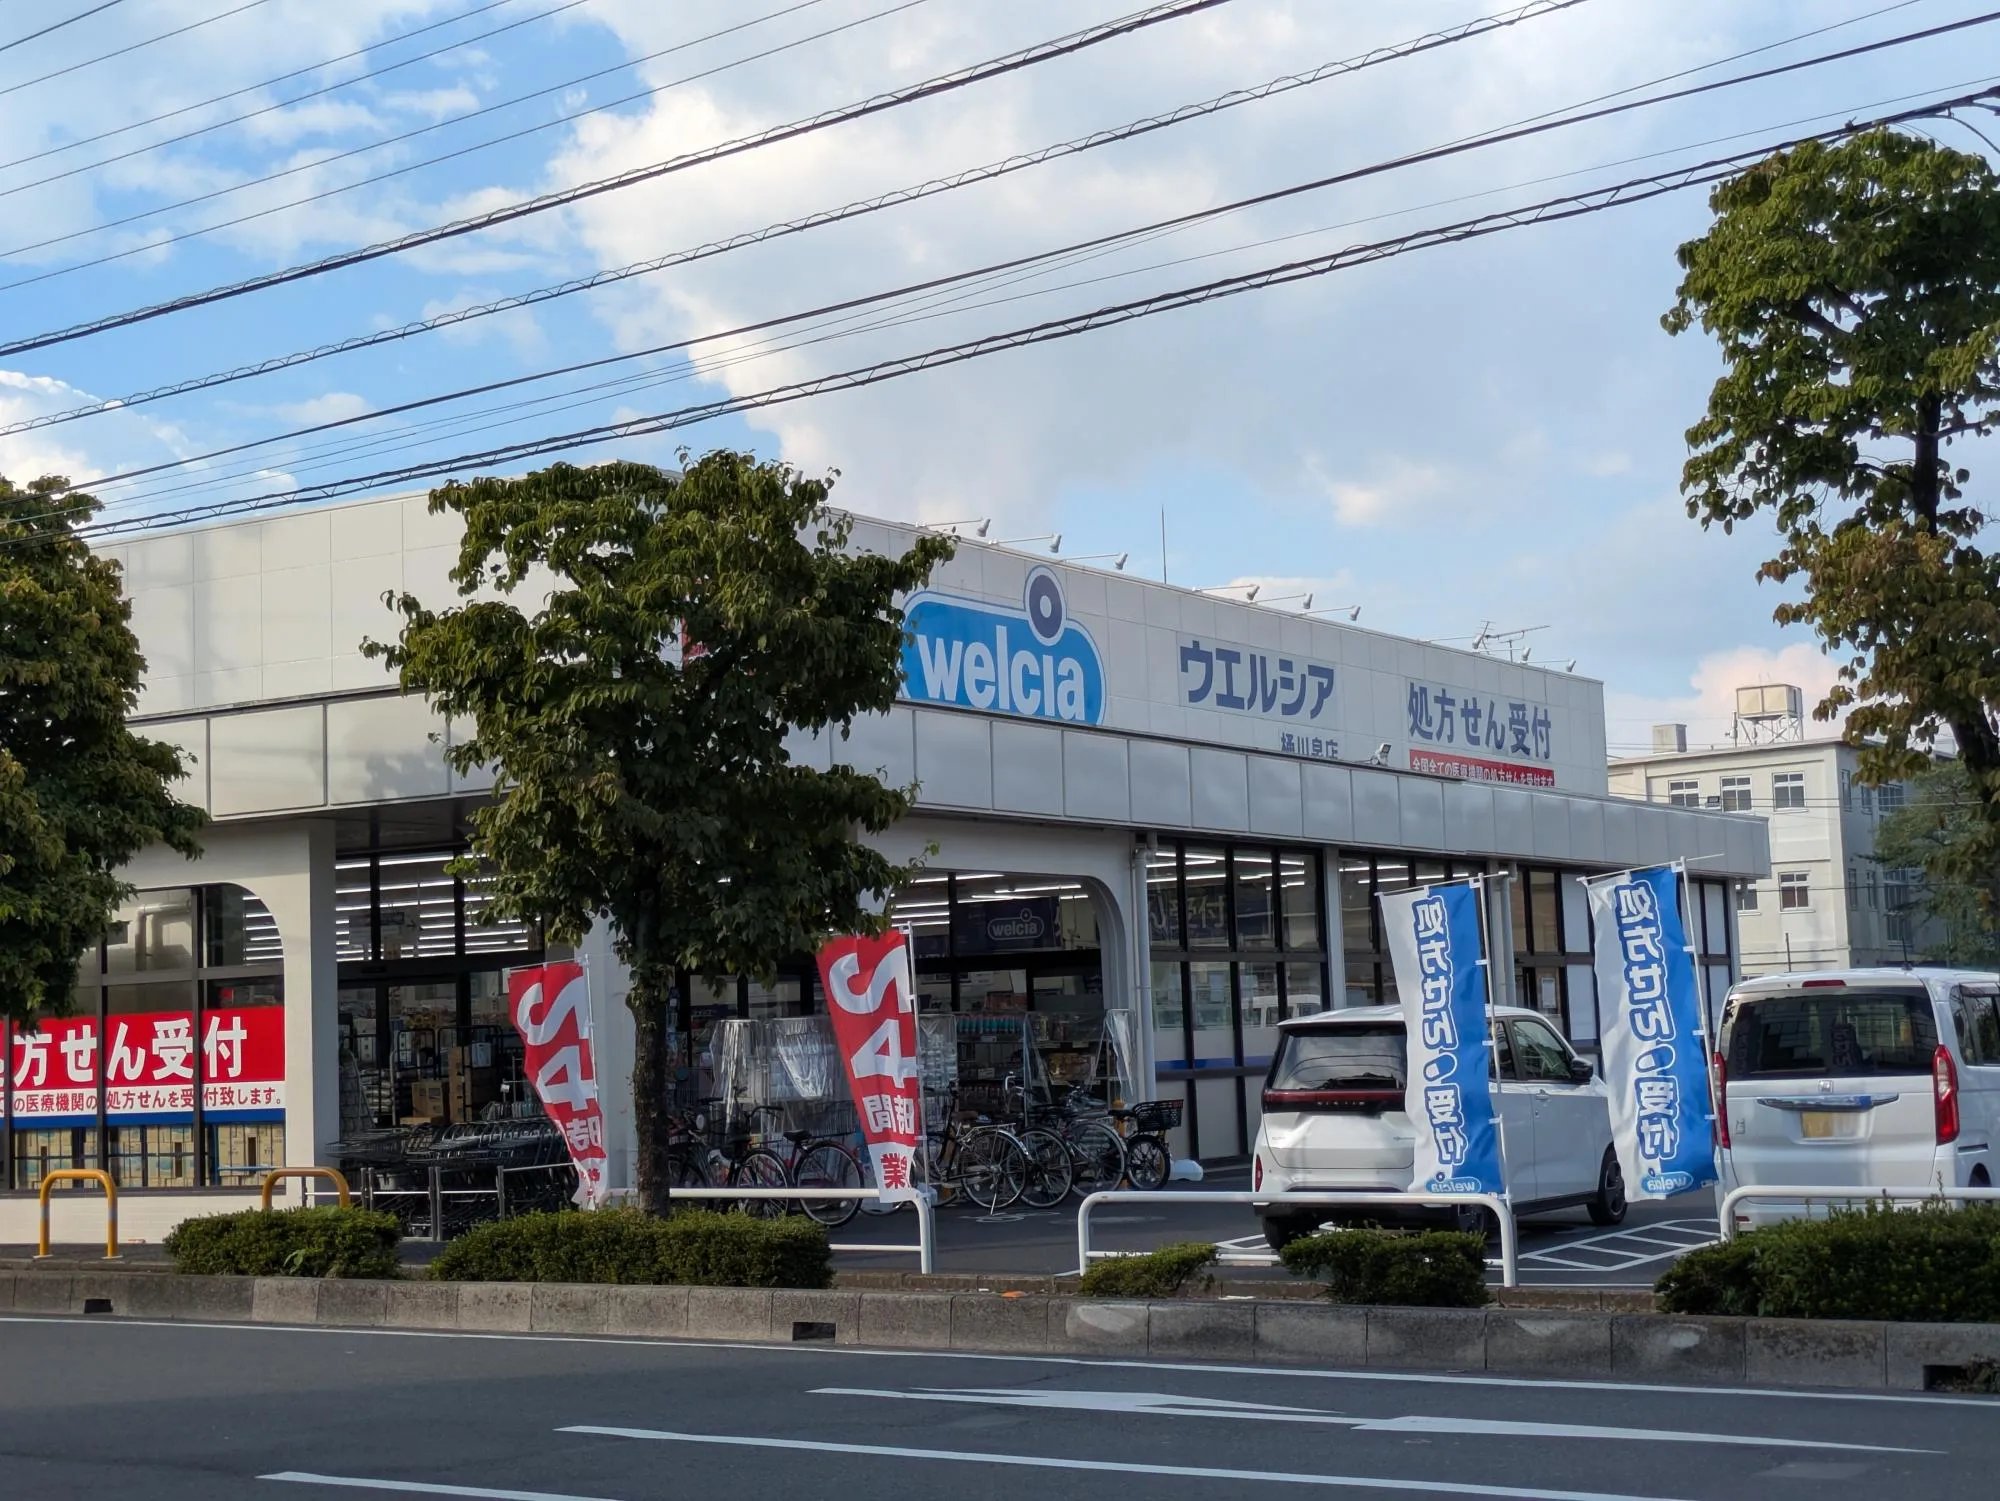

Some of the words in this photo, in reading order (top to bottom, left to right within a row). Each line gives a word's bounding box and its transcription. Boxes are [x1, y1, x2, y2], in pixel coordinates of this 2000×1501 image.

[916, 625, 1085, 721] welcia
[1179, 640, 1335, 719] ウエルシア
[1408, 682, 1552, 760] 処方せん受付
[991, 917, 1037, 938] welcia
[0, 1016, 247, 1087] 方せん受付
[0, 1086, 281, 1113] の医療機関の処方せんを受付致します。
